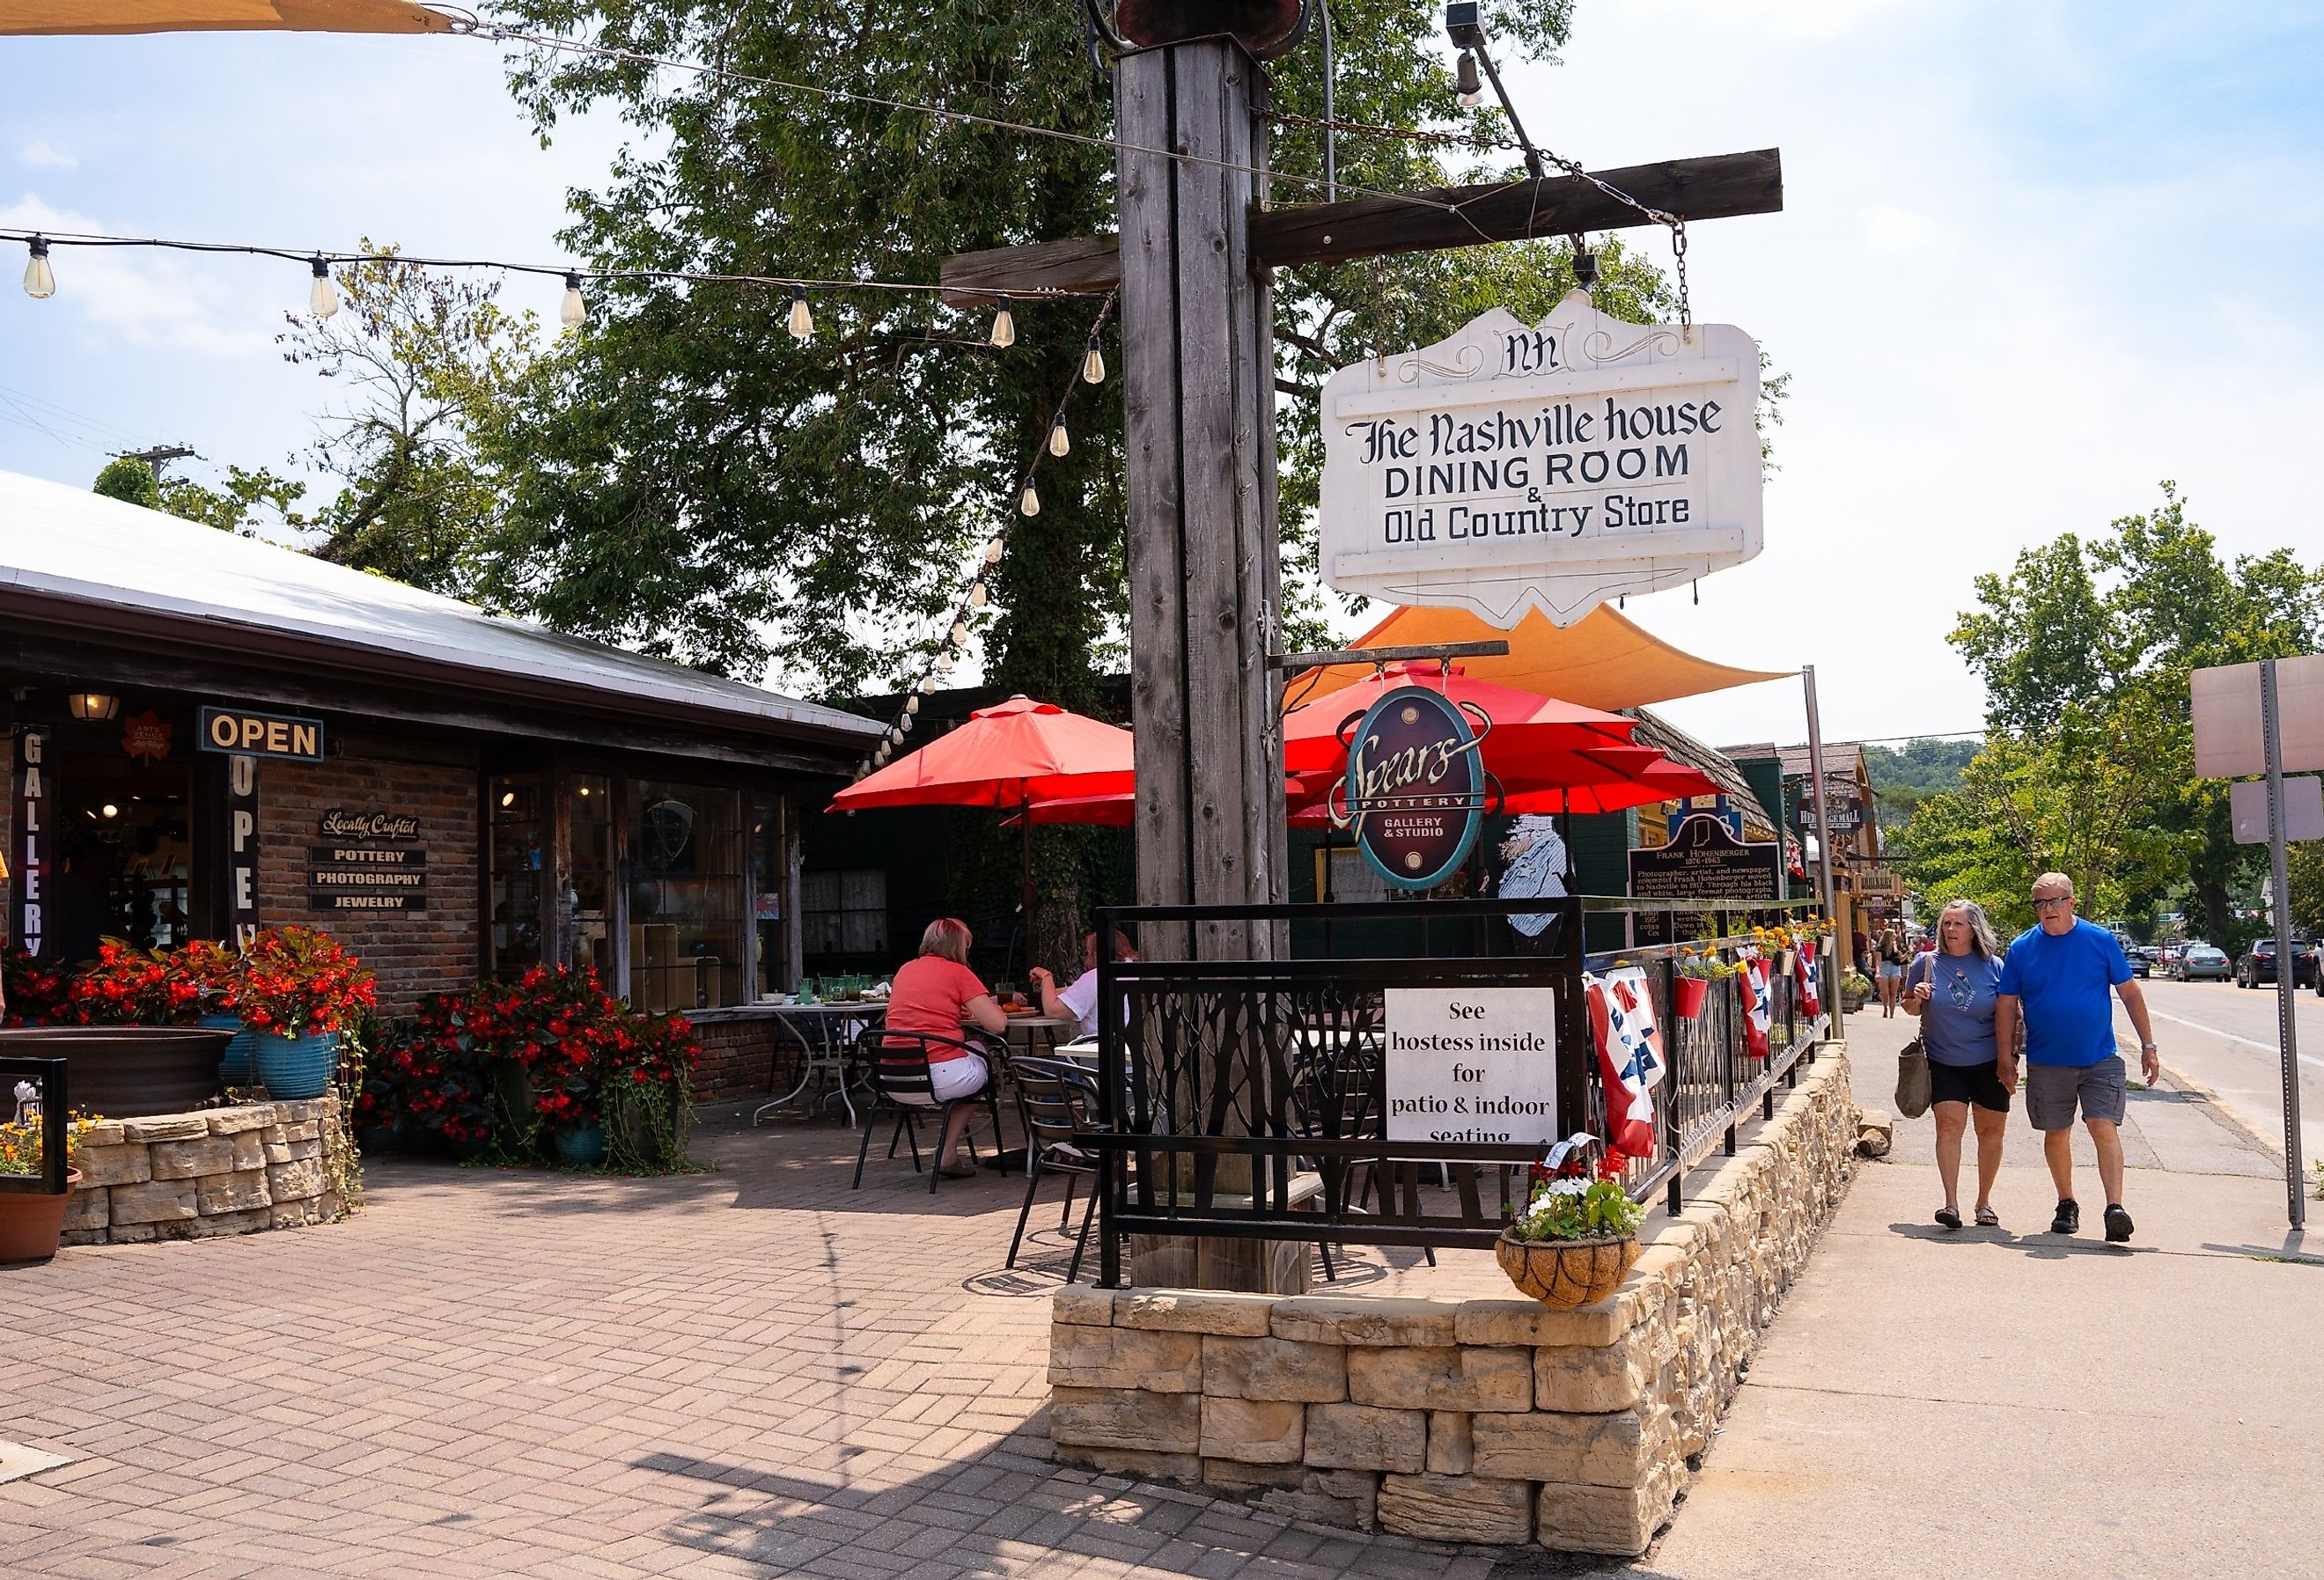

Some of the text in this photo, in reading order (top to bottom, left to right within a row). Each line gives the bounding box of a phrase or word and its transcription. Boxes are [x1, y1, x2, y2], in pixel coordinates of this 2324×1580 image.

[1345, 418, 1418, 464] The
[1430, 403, 1596, 457] Nashville
[1385, 444, 1689, 499] DINING ROOM
[1527, 486, 1543, 503] &
[1385, 495, 1690, 544] Old Country Store
[211, 714, 316, 756] OPEN
[1361, 797, 1466, 810] POTTERY
[1384, 817, 1443, 828] GALLERY
[1839, 809, 1860, 824] MALL
[322, 811, 417, 840] Locally Crafted
[1383, 827, 1444, 838] & STUDIO
[24, 732, 42, 957] GALLERY
[334, 849, 406, 863] POTTERY
[316, 872, 421, 886] PHOTOGRAPHY
[1646, 882, 1679, 891] Nashville
[1676, 888, 1696, 897] large
[335, 896, 405, 908] JEWELRY
[1449, 1002, 1486, 1020] See
[1392, 1032, 1546, 1052] hostess inside
[1452, 1062, 1486, 1083] for
[1391, 1094, 1550, 1117] patio & indoor
